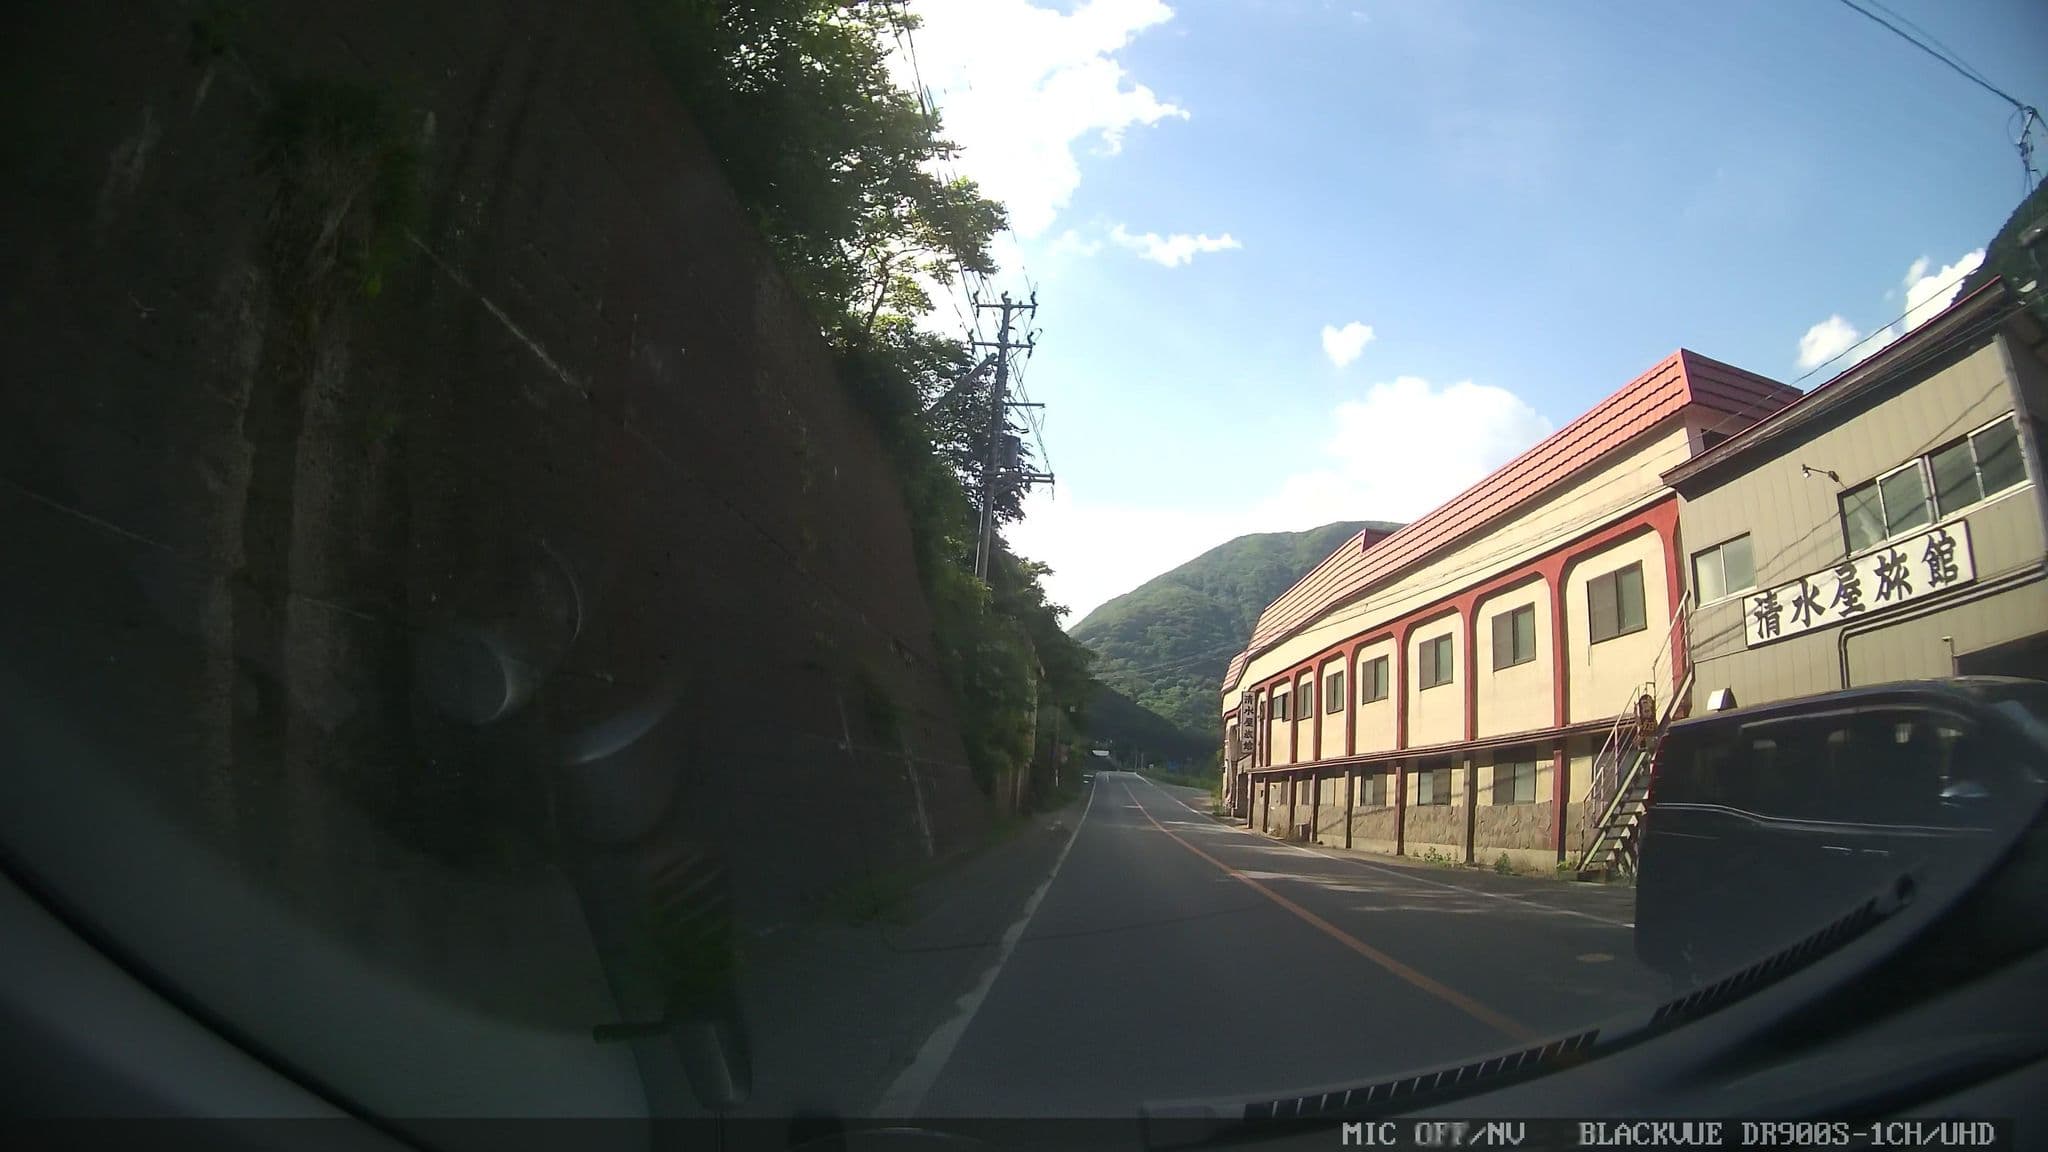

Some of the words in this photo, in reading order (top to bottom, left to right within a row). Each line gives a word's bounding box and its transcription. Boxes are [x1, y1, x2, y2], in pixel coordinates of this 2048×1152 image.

[1753, 529, 1958, 640] 清水屋旅館
